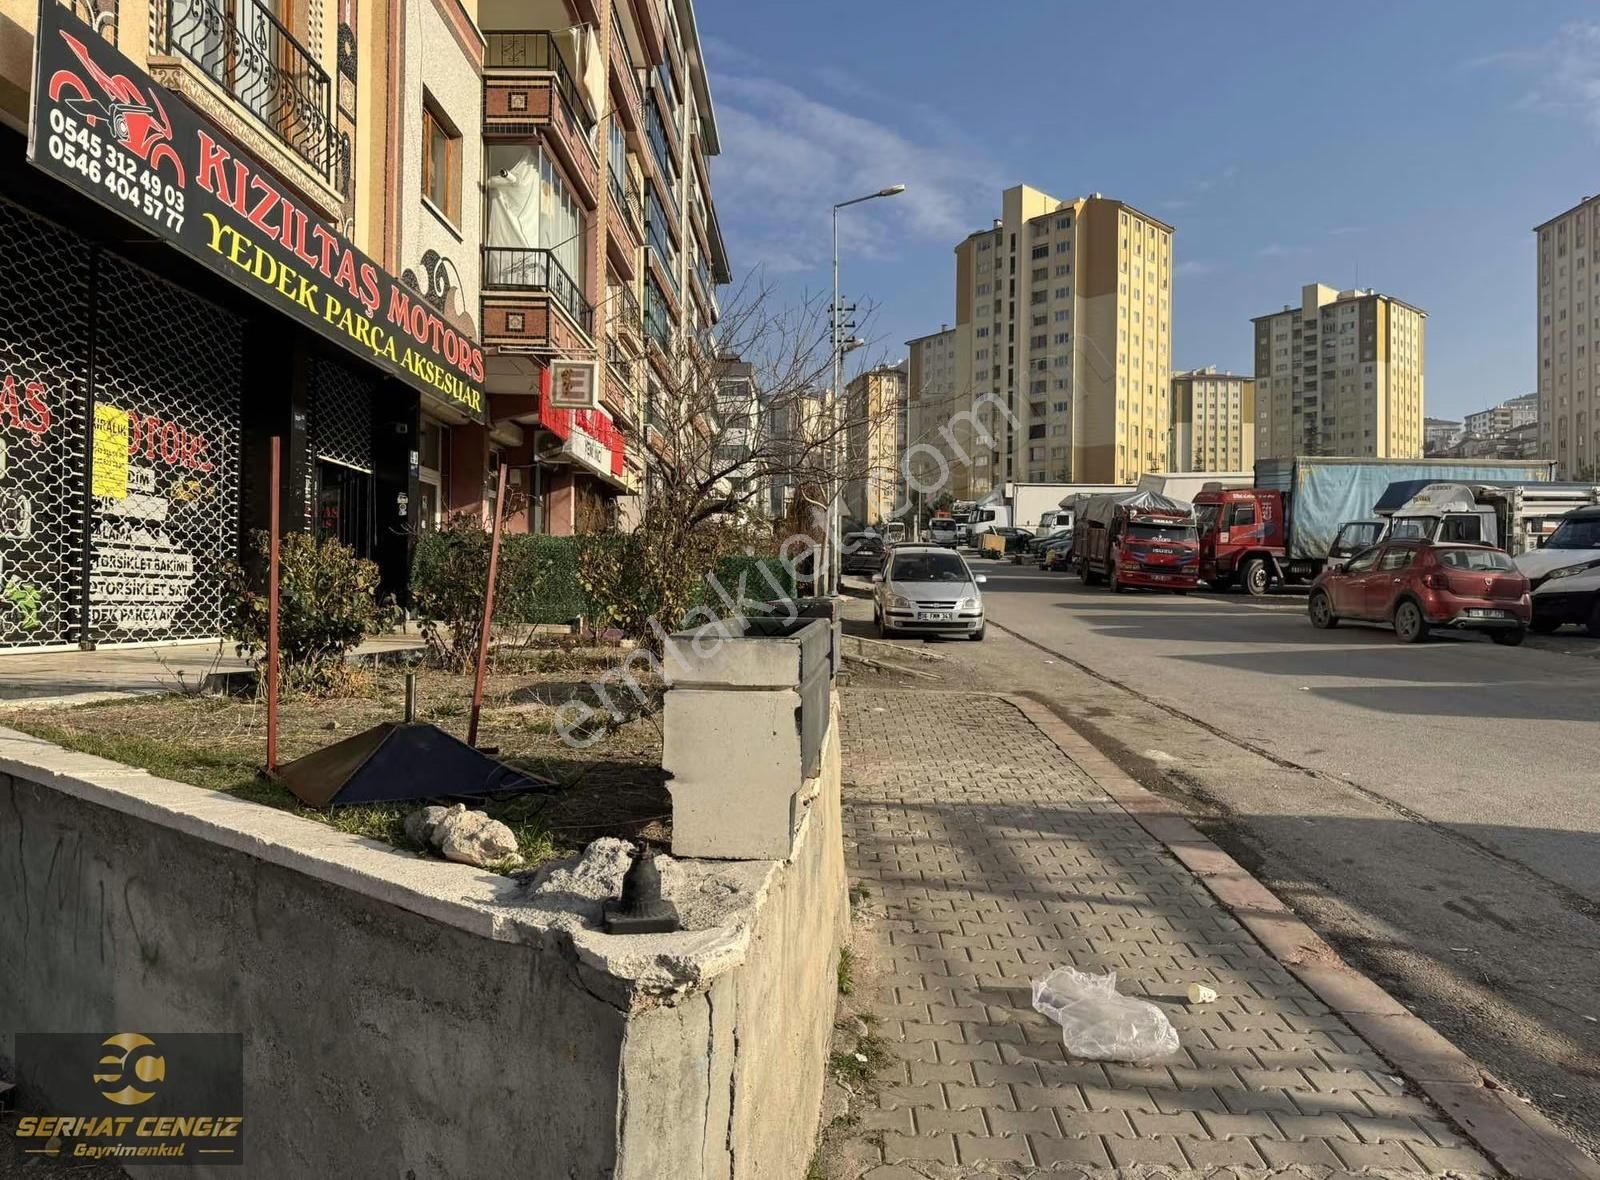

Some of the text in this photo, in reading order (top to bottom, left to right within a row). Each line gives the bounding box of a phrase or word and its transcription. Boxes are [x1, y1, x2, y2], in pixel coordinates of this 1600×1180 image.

[48, 134, 185, 234] 0546 404 57 77
[50, 108, 185, 212] 0545 312 49 03
[195, 129, 485, 384] KIZILTAŞ MOTORS
[202, 212, 482, 413] YEDEK PARÇA AKSESUAR
